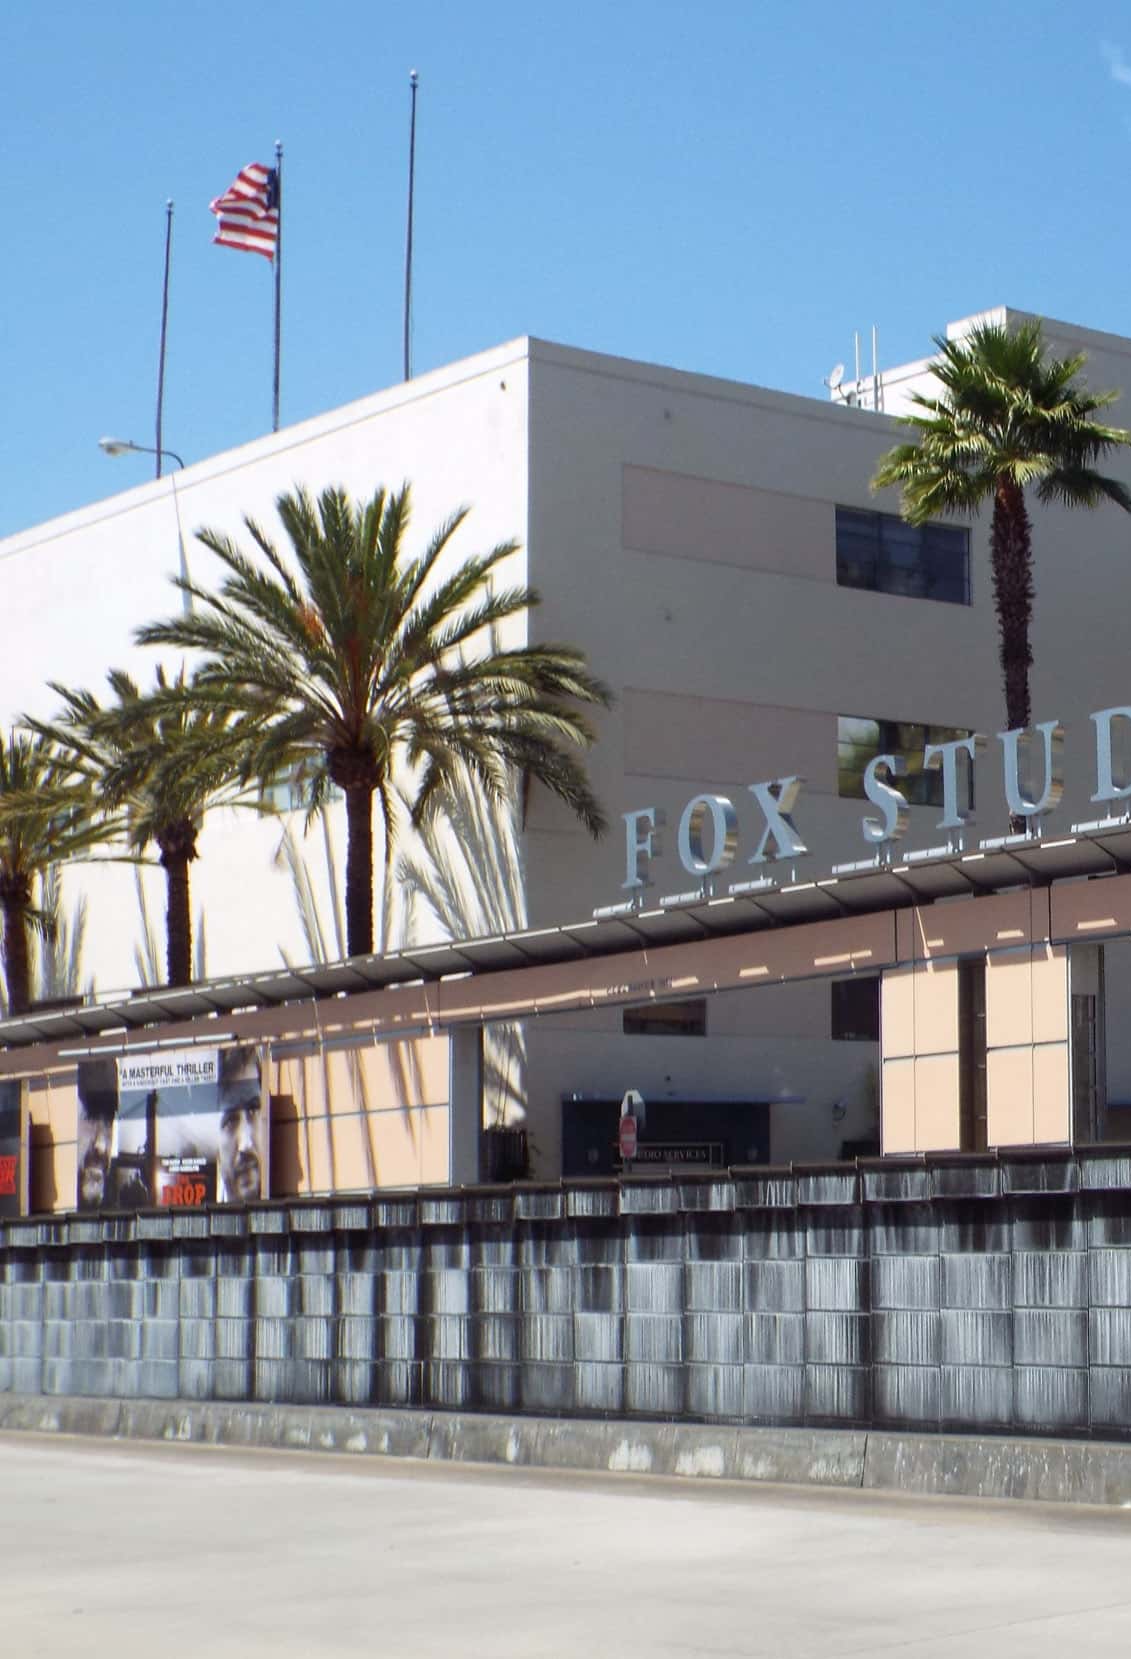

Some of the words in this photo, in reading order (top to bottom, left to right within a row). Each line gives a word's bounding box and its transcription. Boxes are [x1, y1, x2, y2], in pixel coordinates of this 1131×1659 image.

[621, 775, 810, 889] FOX
[129, 1064, 173, 1079] MASTERFUL
[176, 1061, 214, 1075] THRILLER
[162, 1183, 206, 1206] DROP
